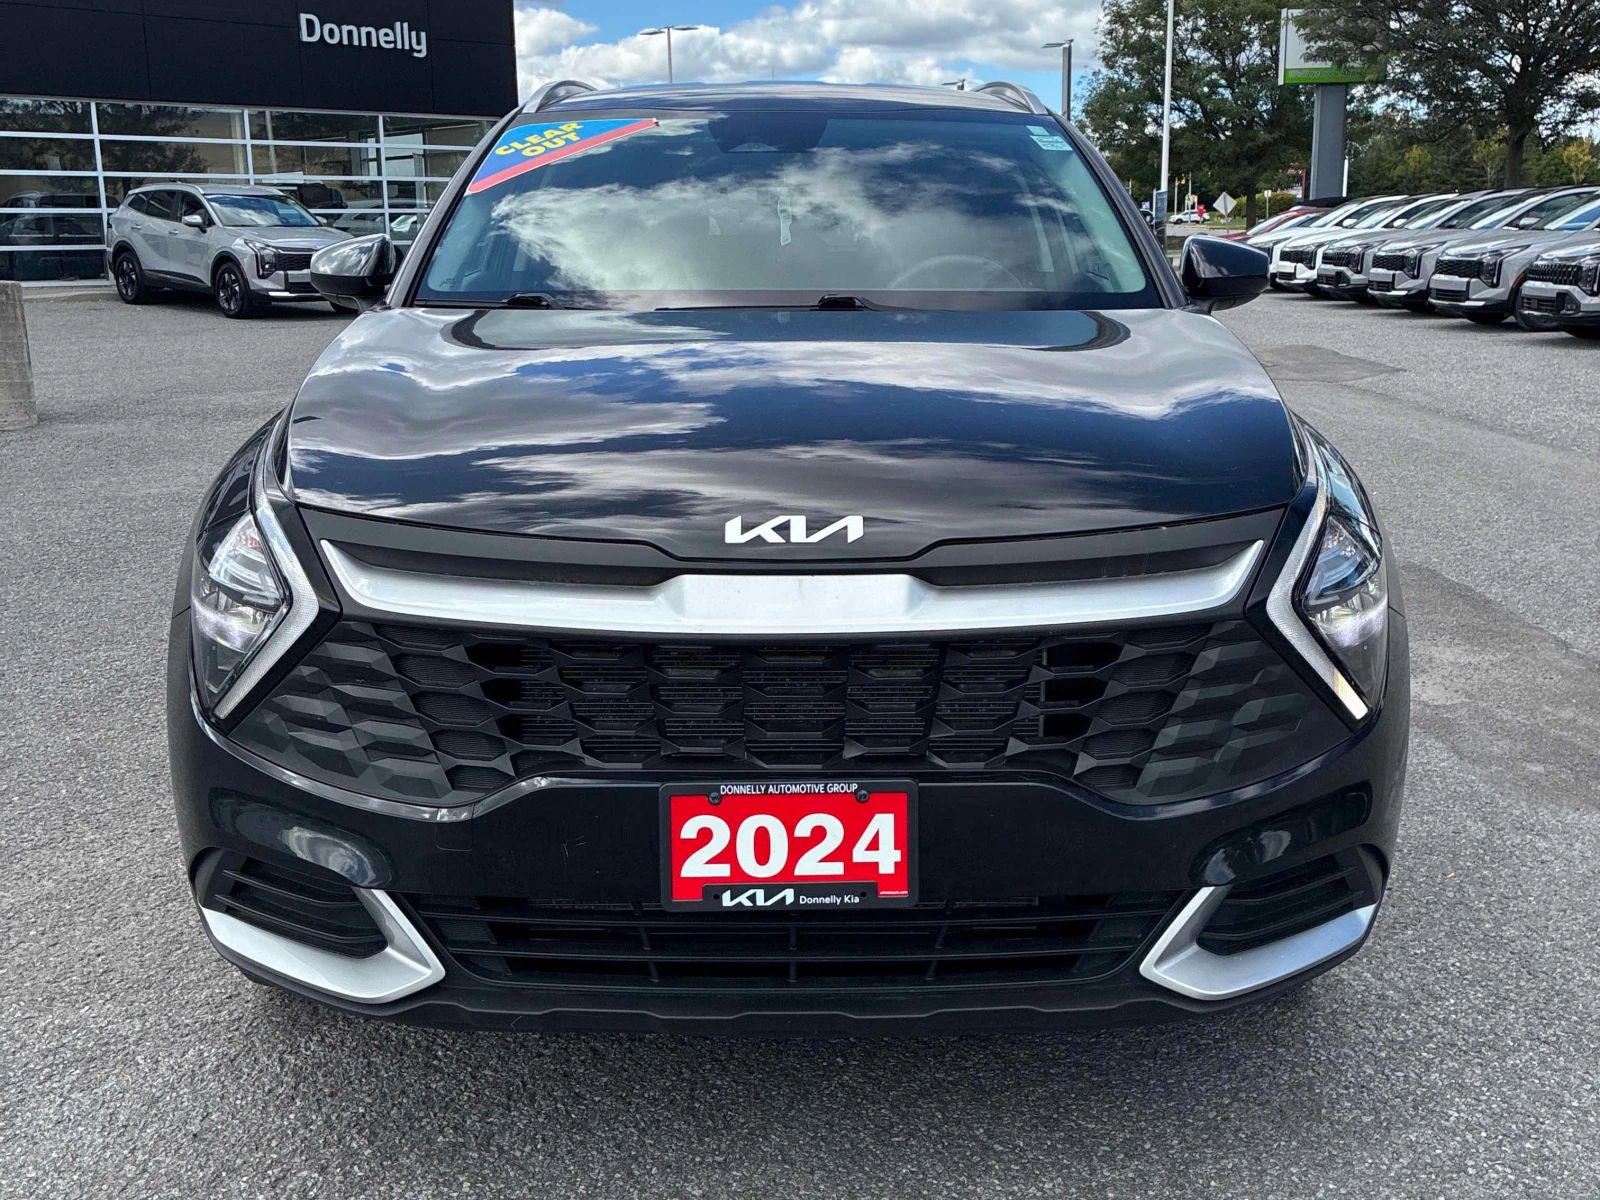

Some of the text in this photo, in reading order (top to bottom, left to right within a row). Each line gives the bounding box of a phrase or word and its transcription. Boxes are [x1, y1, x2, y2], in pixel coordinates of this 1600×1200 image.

[299, 12, 427, 58] Donnelly
[495, 123, 584, 156] CLEAR
[522, 132, 581, 156] OUT
[725, 515, 864, 543] KIA
[720, 783, 858, 795] DONNELLY AUTOMOTIVE GROUP
[680, 813, 901, 878] 2024
[722, 888, 794, 907] KIA
[800, 894, 860, 906] Donnelly Kia
